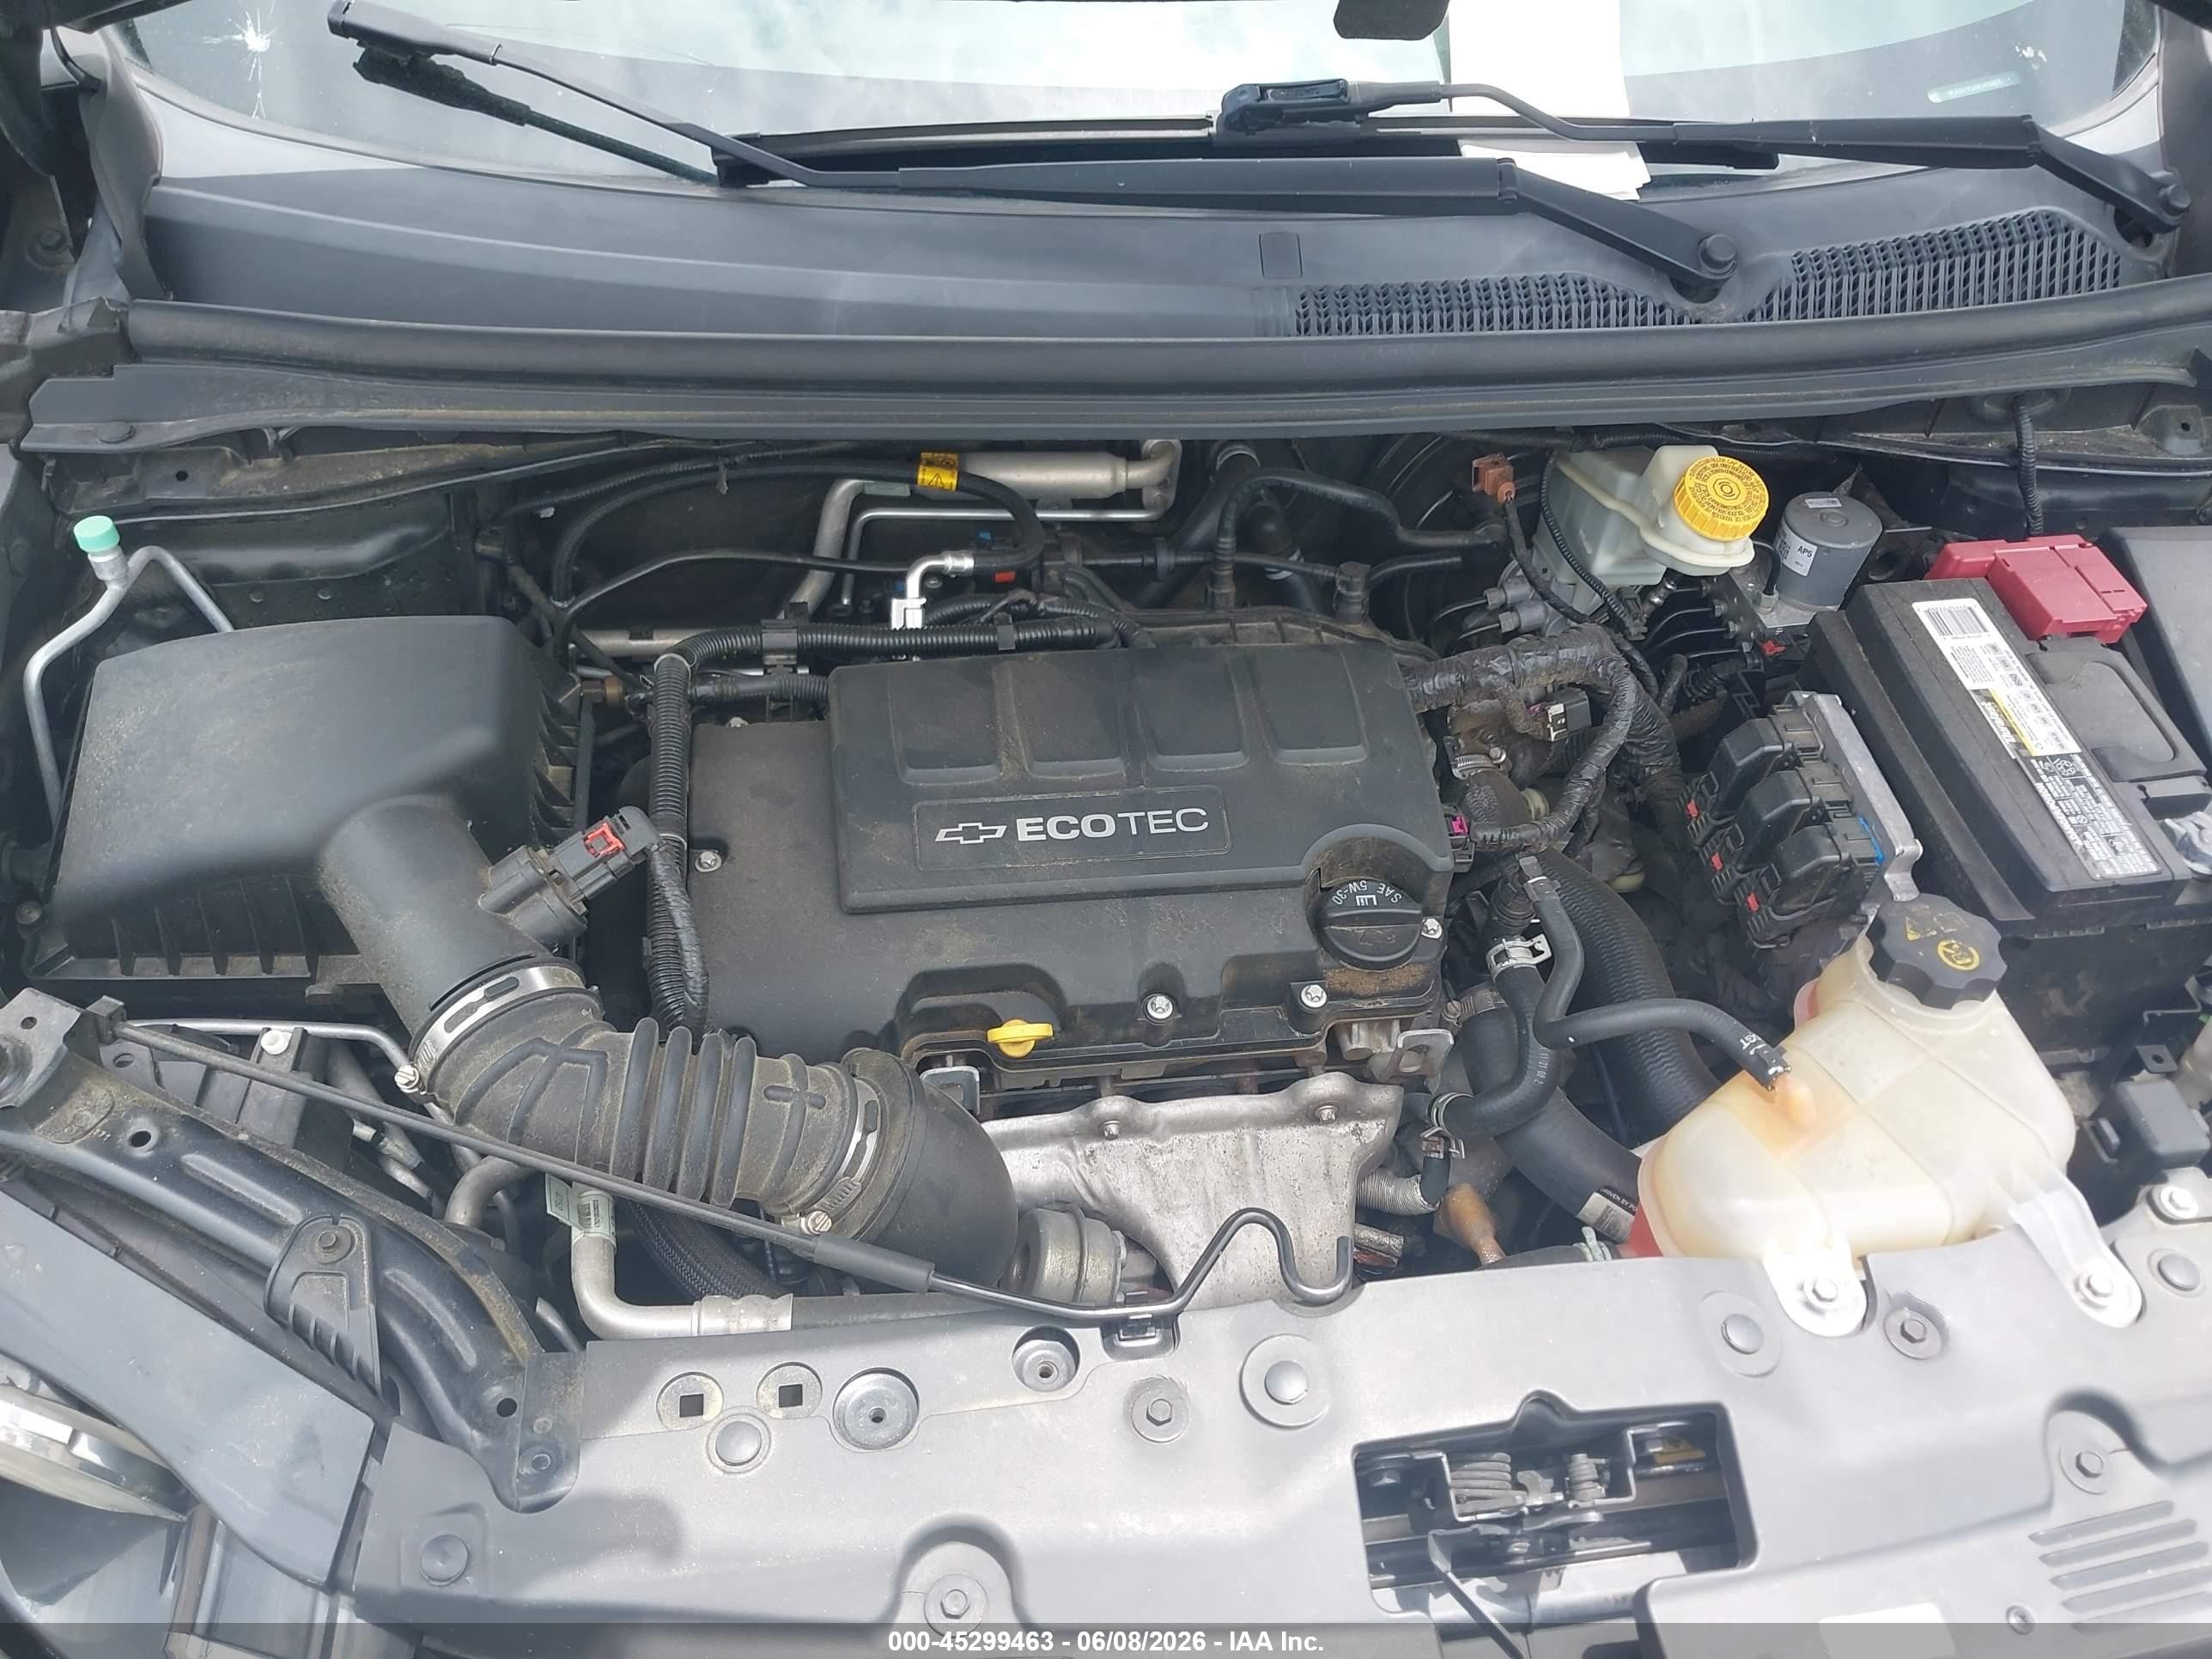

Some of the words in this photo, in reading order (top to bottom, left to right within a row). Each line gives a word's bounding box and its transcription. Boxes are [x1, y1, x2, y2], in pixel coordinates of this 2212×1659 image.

[1797, 545, 1813, 558] AP5
[1978, 701, 2018, 743] Duralast
[1016, 807, 1210, 842] ECOTEC
[1332, 879, 1368, 905] 5W-30
[1376, 882, 1402, 903] SAE
